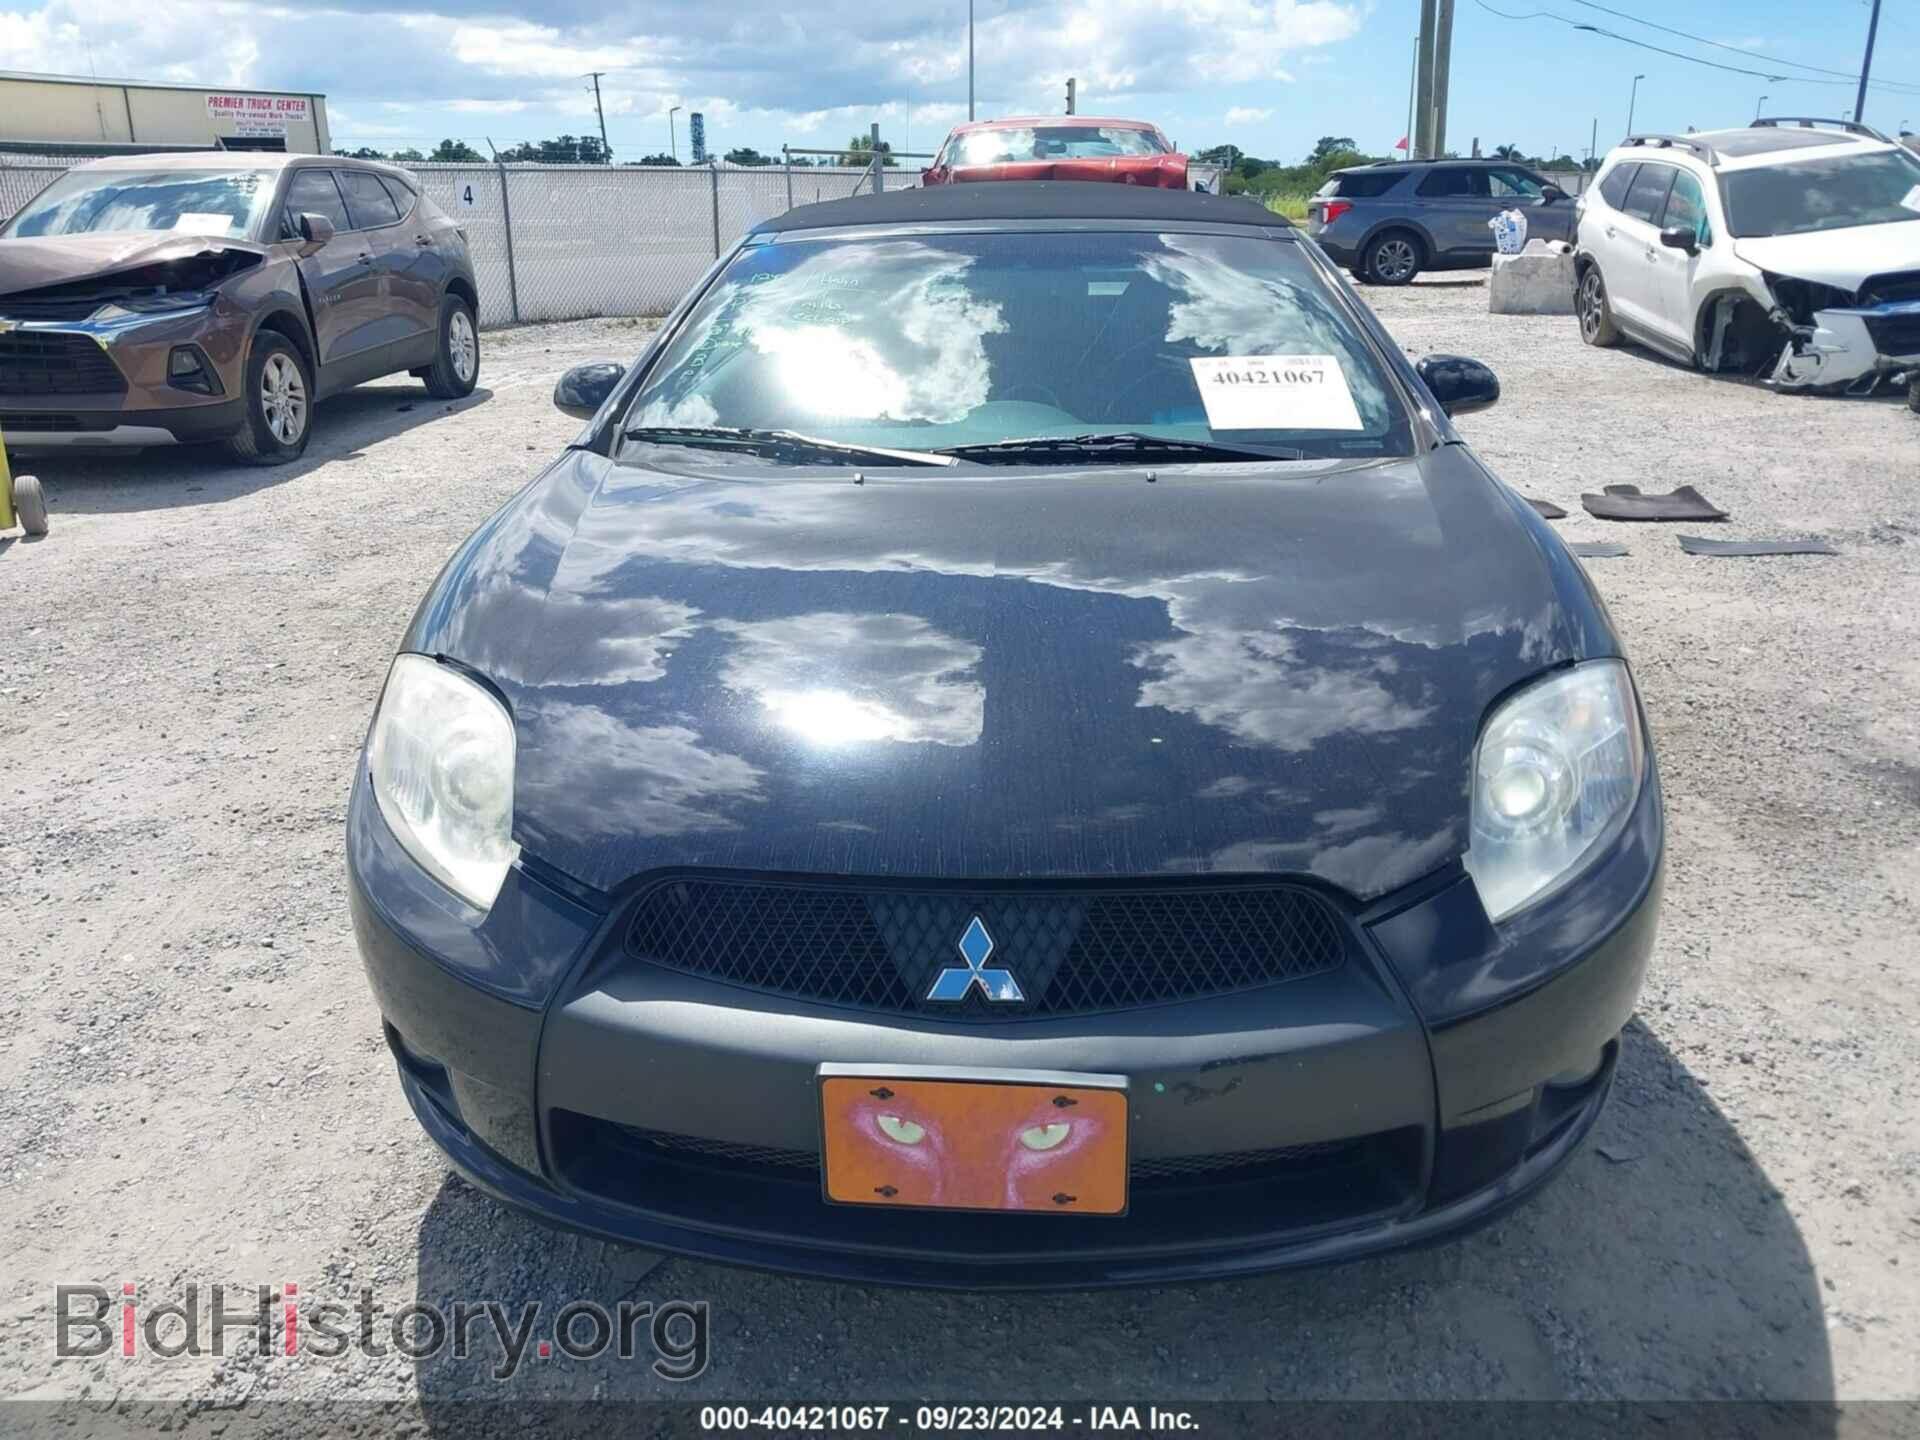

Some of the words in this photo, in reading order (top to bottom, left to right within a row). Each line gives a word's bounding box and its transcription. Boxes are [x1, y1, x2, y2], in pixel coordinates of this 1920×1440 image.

[208, 96, 243, 109] PREMIER
[247, 98, 273, 110] TRUCK
[276, 99, 306, 112] CENTER
[463, 185, 474, 205] 4
[1213, 370, 1324, 385] 40421067
